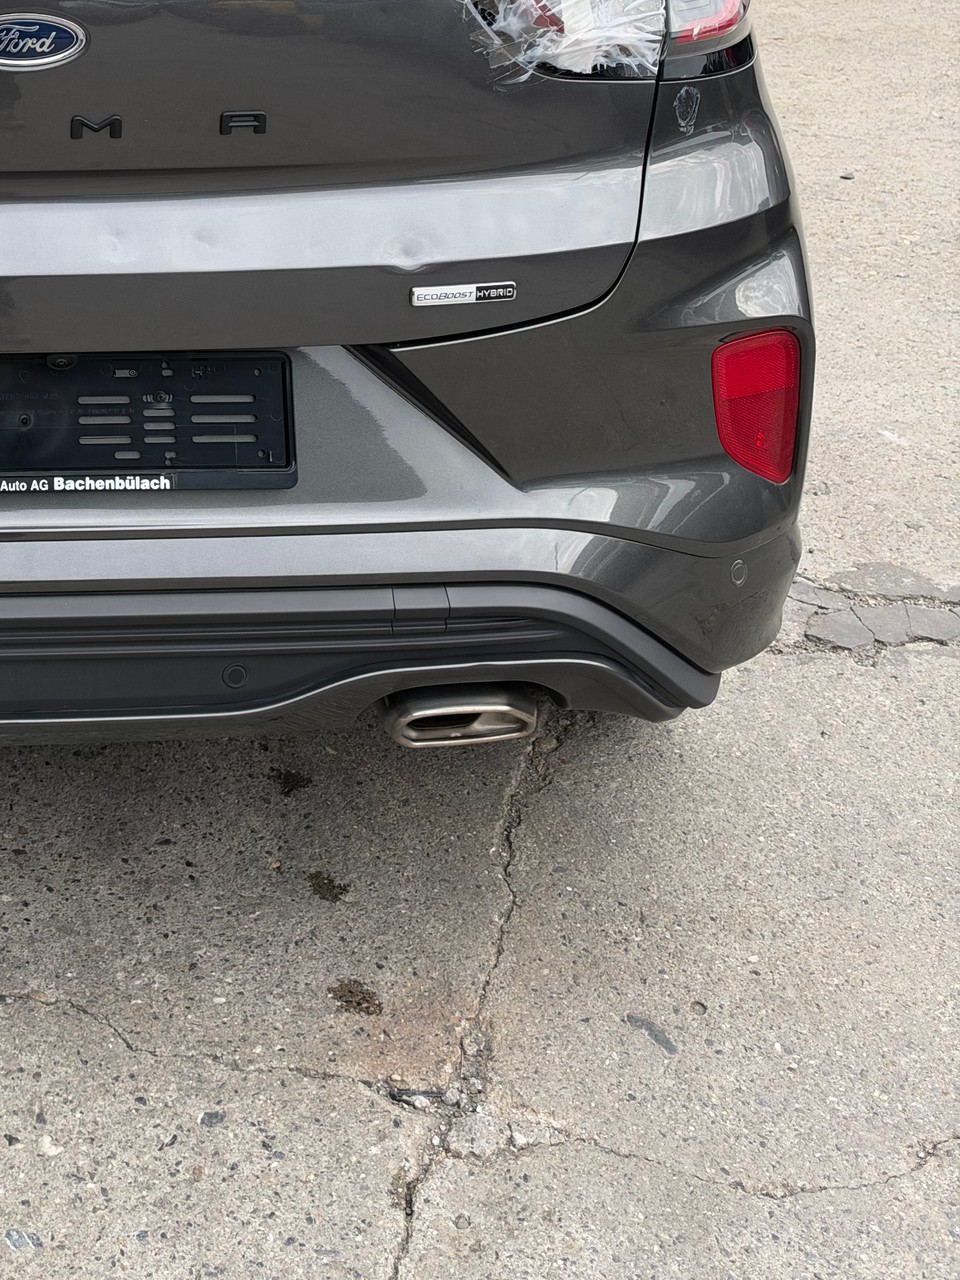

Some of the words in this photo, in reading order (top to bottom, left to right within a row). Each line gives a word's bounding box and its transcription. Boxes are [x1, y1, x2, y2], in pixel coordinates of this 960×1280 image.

[476, 287, 513, 298] HYBRID
[0, 480, 28, 492] Auto
[30, 479, 49, 491] AG
[53, 476, 171, 491] Bachenbülach
